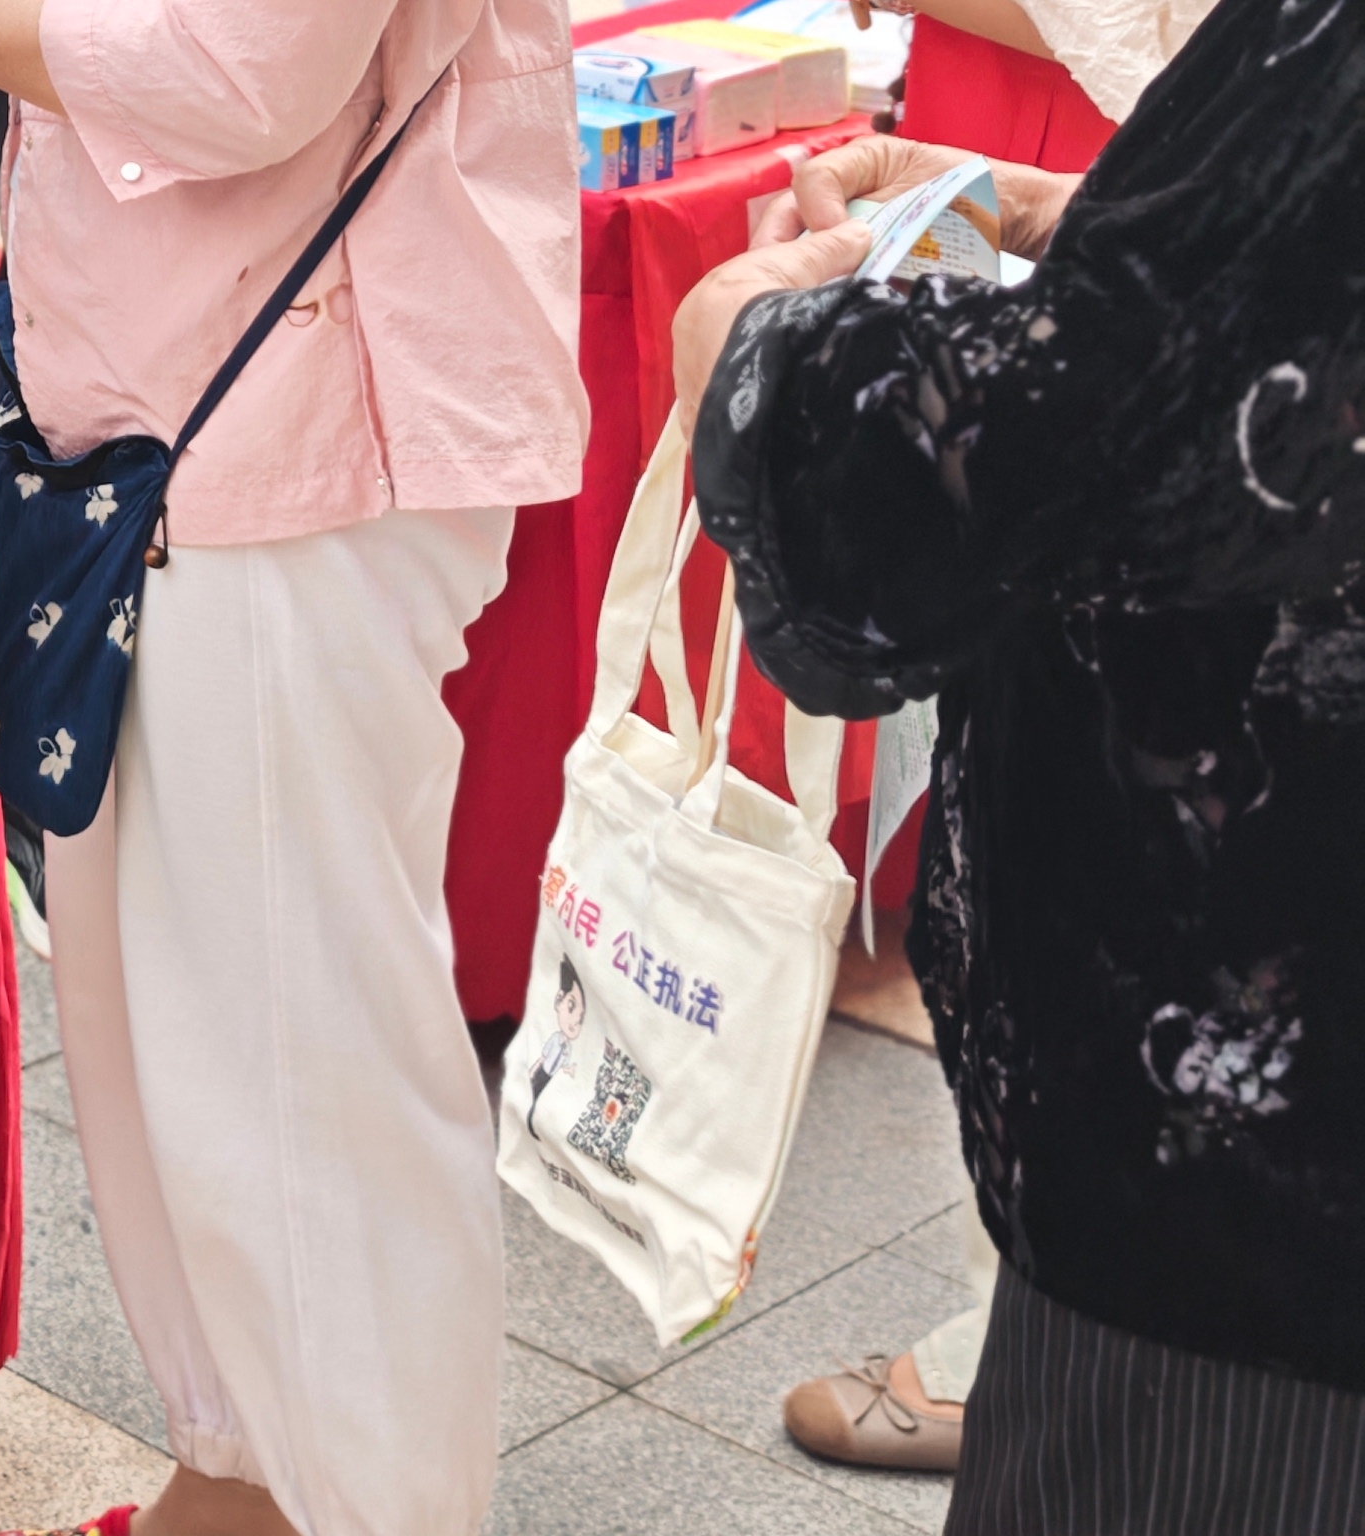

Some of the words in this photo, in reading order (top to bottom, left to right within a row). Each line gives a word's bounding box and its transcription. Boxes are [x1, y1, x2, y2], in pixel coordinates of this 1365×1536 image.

[541, 865, 602, 948] 察为民
[612, 930, 721, 1035] 公正执法
